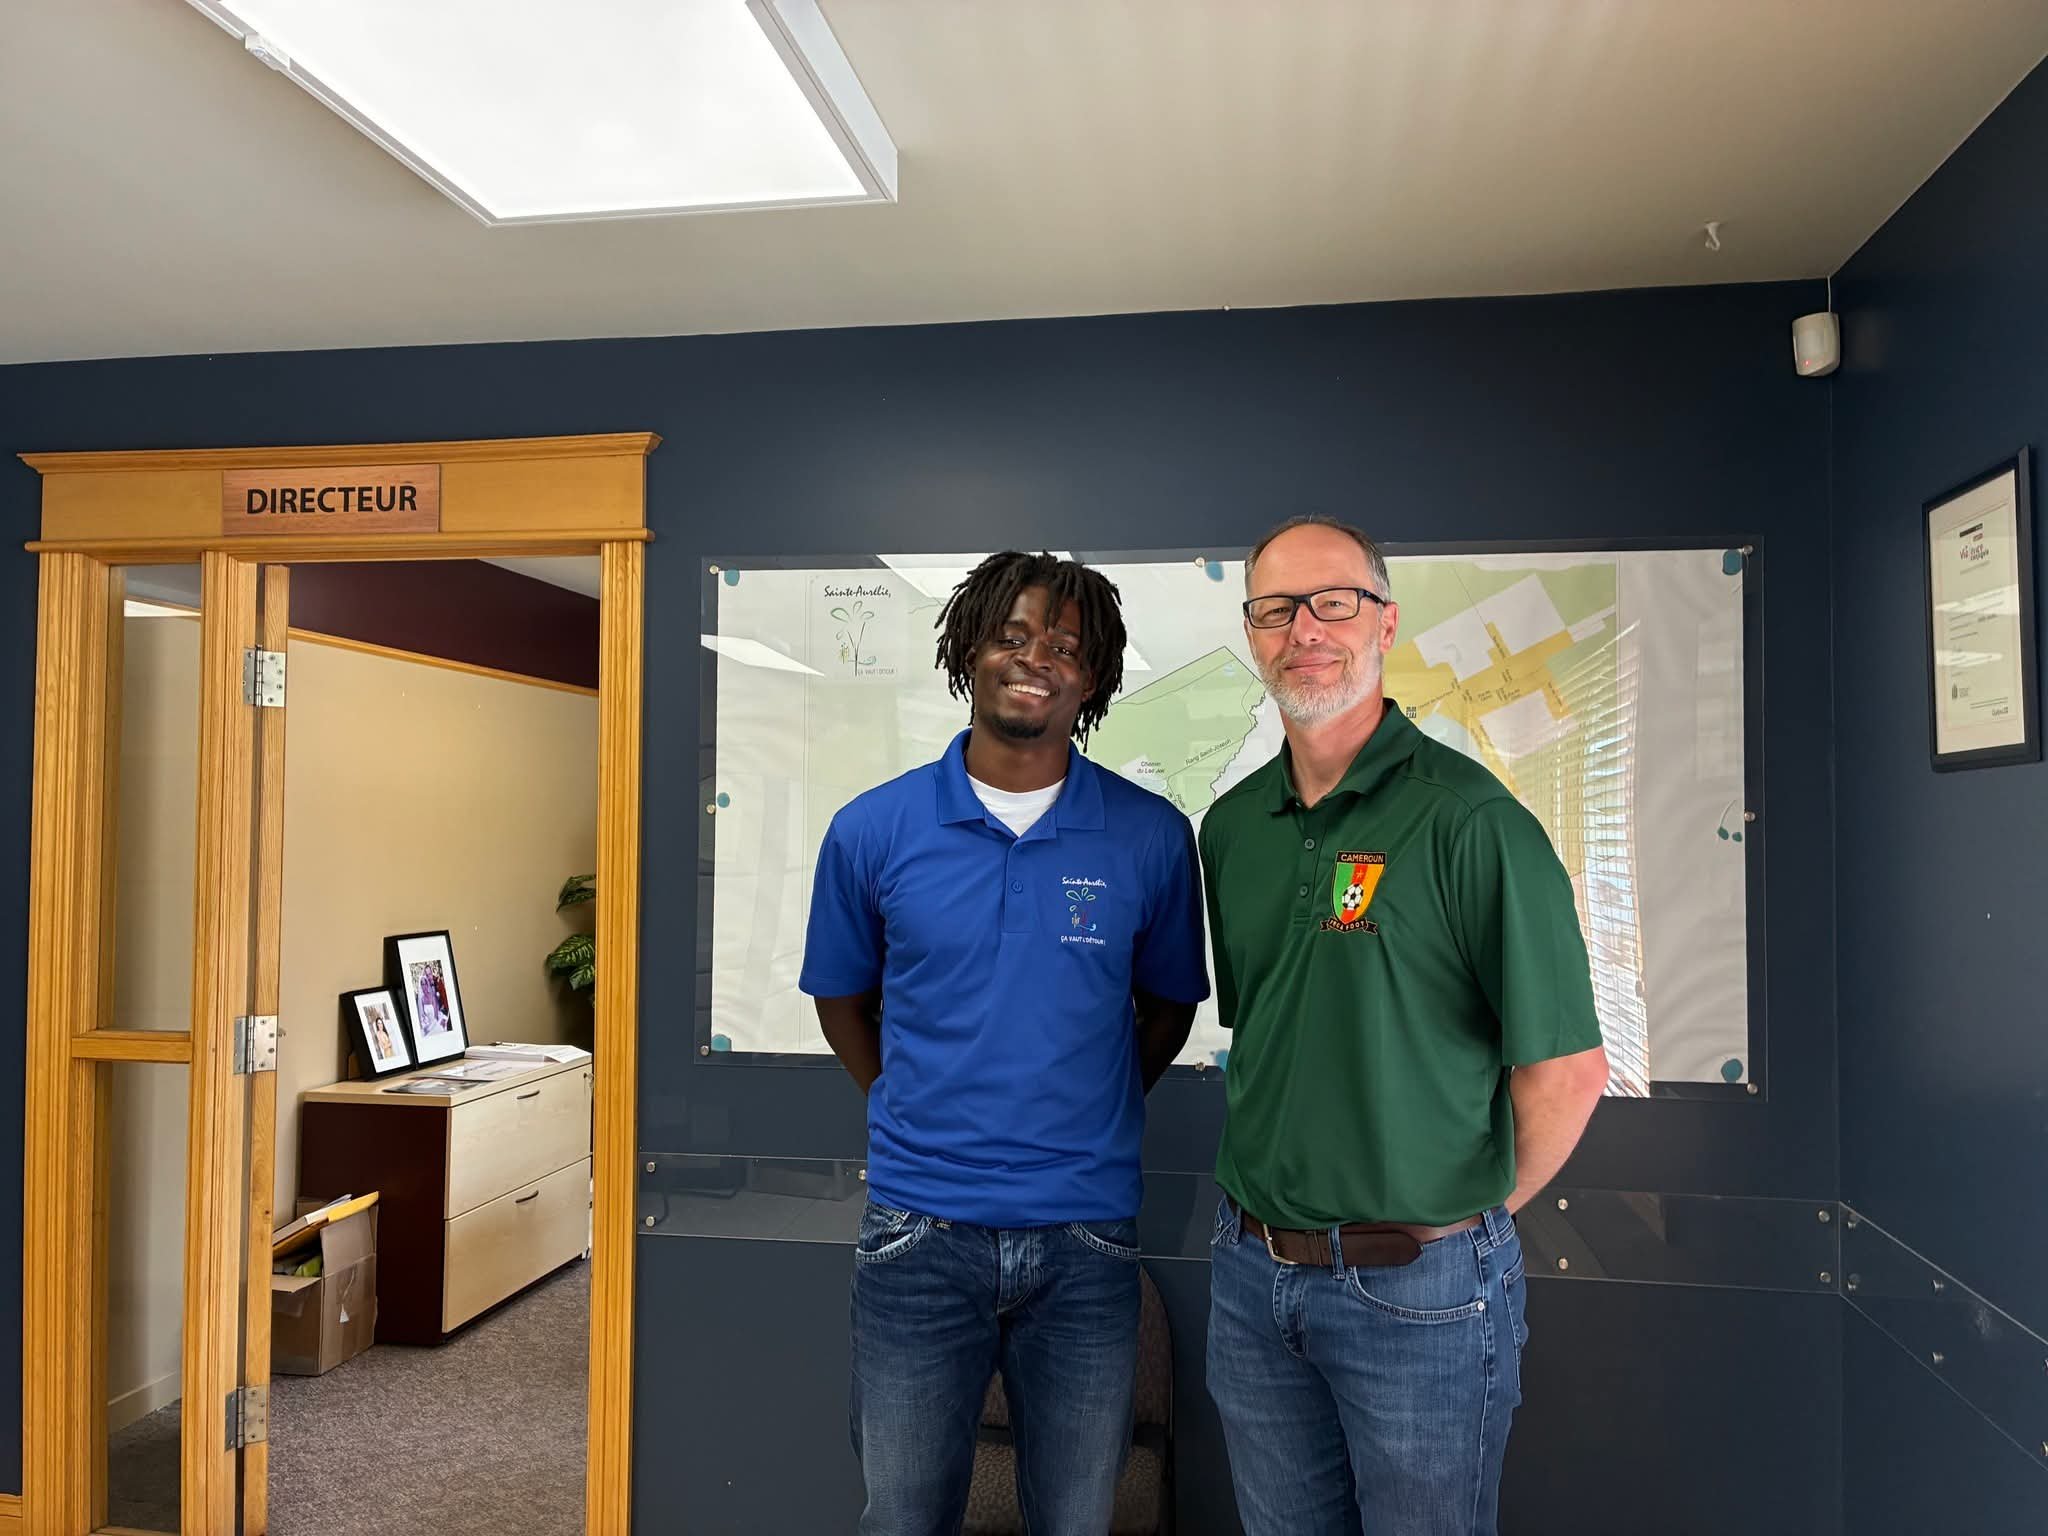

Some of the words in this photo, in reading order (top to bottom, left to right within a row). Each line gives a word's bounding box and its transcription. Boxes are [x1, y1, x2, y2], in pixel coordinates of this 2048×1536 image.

[246, 485, 417, 514] DIRECTEUR
[1340, 854, 1384, 863] CAMEROUN
[1060, 935, 1068, 943] ÇA
